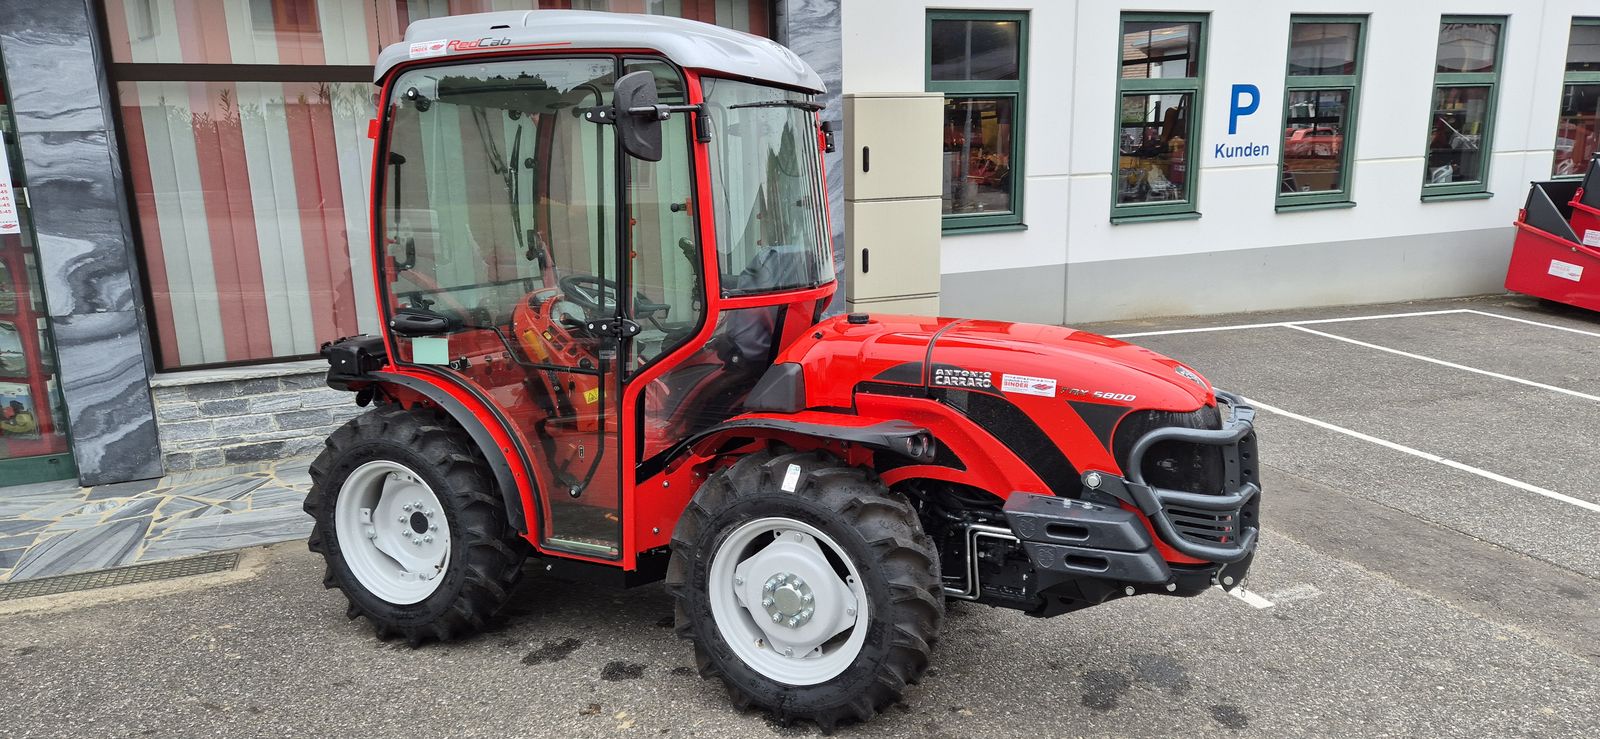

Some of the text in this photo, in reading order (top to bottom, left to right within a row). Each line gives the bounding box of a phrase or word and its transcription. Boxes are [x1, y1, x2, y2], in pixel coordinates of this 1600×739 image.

[446, 37, 511, 50] RedCab
[1228, 84, 1261, 134] P
[1215, 142, 1269, 158] Kunden
[935, 368, 992, 378] ANTONIO
[935, 375, 992, 388] CARRARO
[1093, 390, 1137, 402] 5800
